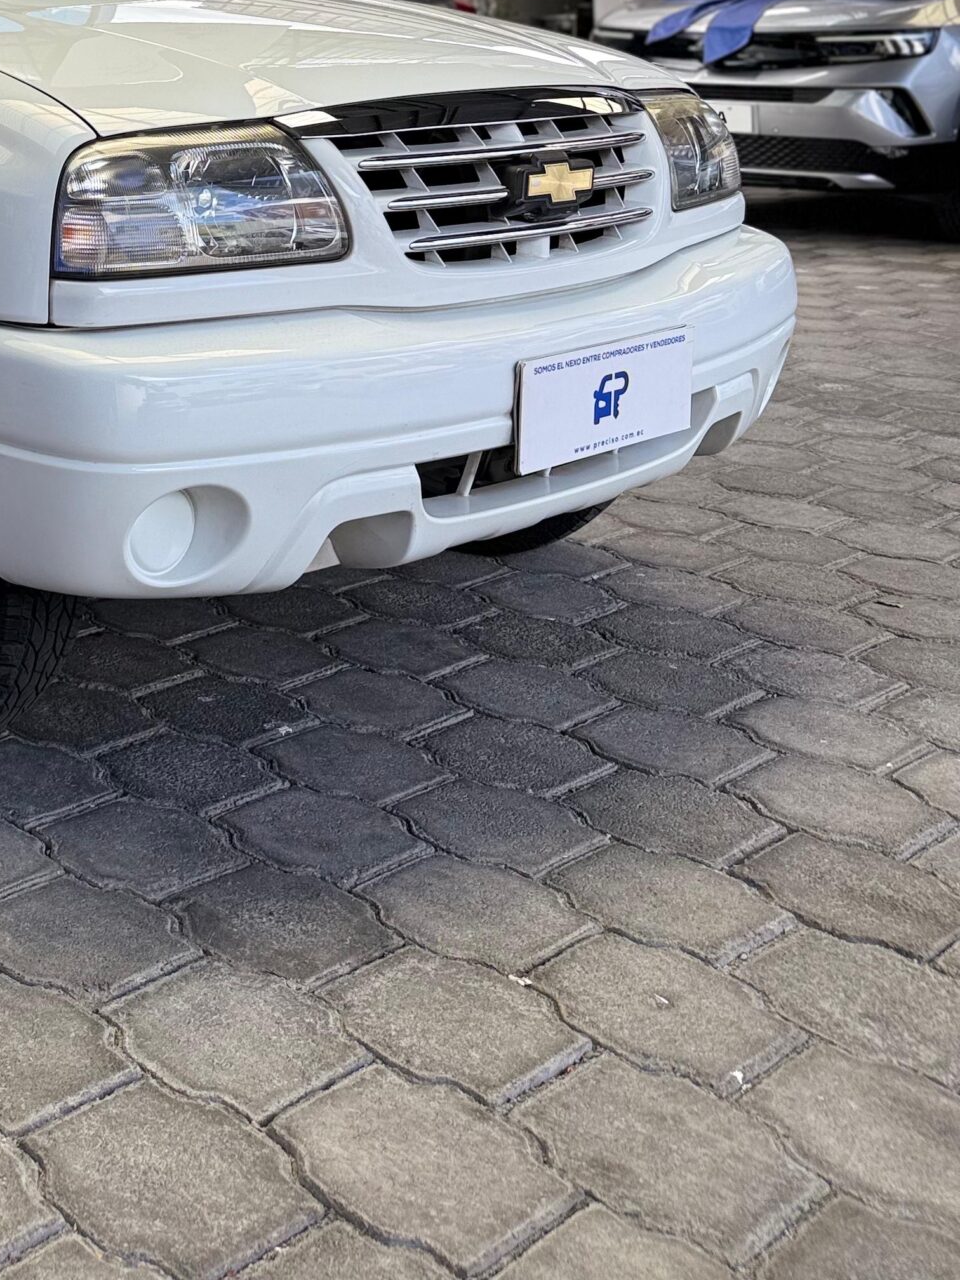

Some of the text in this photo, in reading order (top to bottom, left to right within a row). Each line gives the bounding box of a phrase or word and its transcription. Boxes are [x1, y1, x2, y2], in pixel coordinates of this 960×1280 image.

[533, 334, 686, 376] SOMOS EL NEXO ENTRE COMPRADORES Y VENDEDORES
